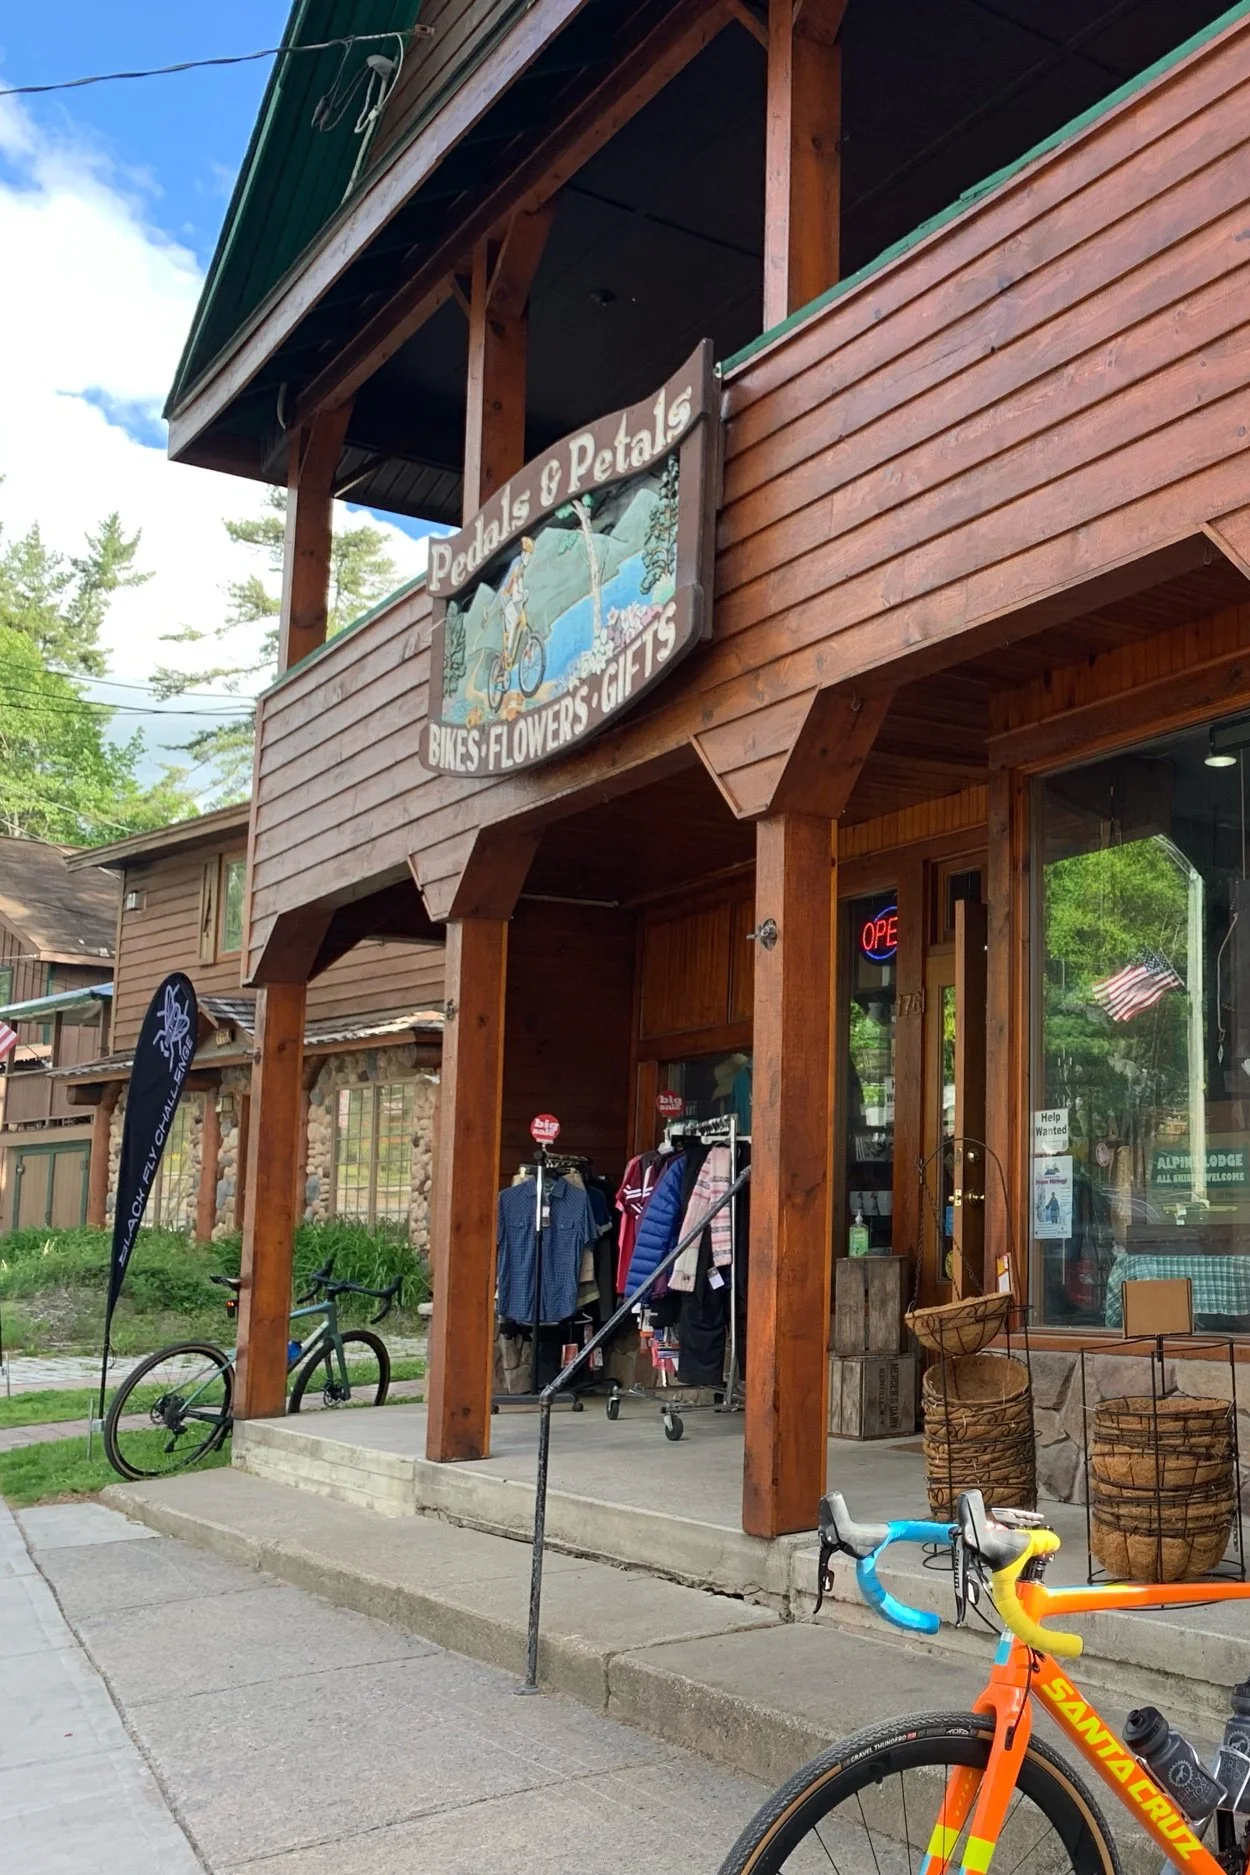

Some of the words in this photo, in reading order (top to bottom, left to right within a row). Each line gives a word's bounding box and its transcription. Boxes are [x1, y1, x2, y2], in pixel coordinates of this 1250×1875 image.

[429, 484, 531, 591] Pedals
[540, 456, 562, 507] &
[568, 384, 692, 493] Petals
[428, 721, 481, 772] BIKES
[488, 689, 588, 770] FLOWERS
[602, 601, 677, 712] GIFTS
[862, 916, 898, 950] OPE
[1036, 1125, 1067, 1137] Wanted
[1041, 1112, 1061, 1123] Help
[119, 1192, 146, 1267] BLACK
[142, 1145, 157, 1186] FLY
[154, 1036, 194, 1147] CHALLENGE
[1157, 1155, 1197, 1170] ALPIN
[1156, 1174, 1171, 1184] ALL
[1173, 1173, 1204, 1183] SKIE
[850, 1748, 873, 1763] GRAVEL
[874, 1734, 907, 1751] THUNDERO
[1041, 1677, 1137, 1781] SANTA
[1128, 1778, 1204, 1861] CRUZ
